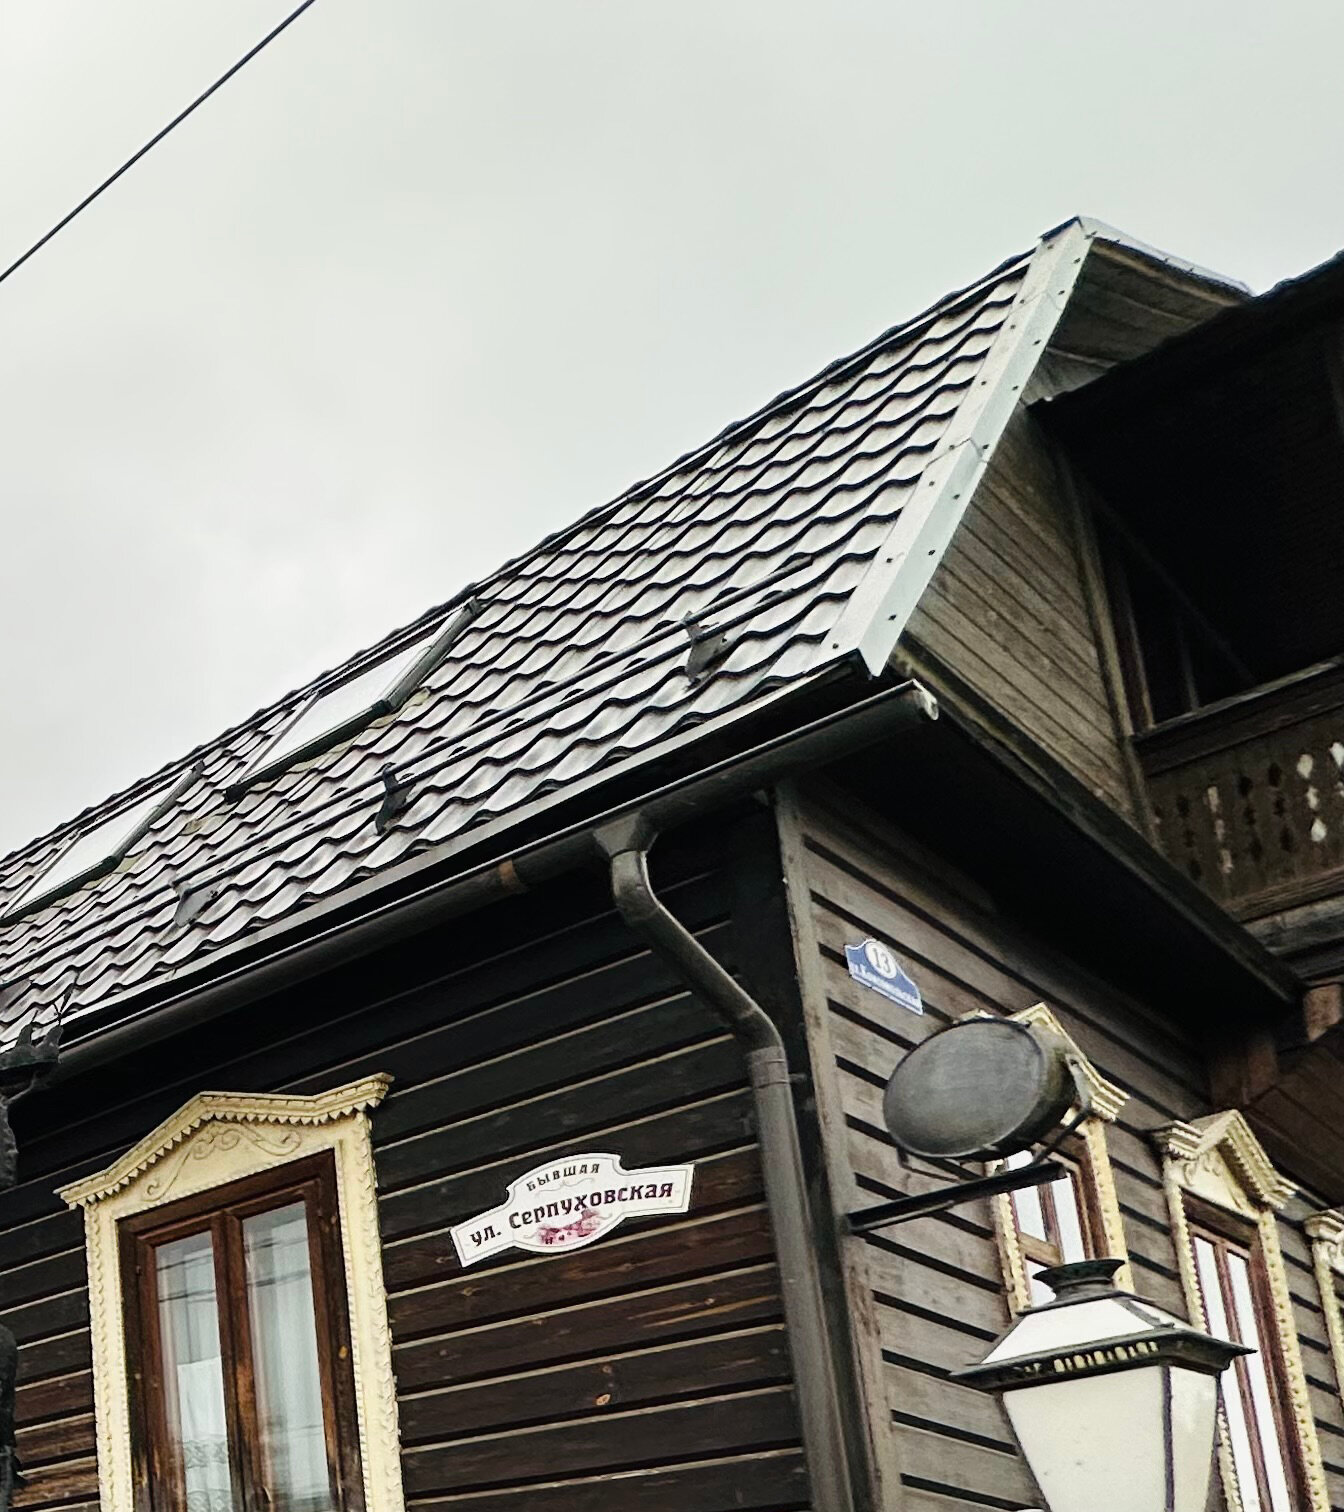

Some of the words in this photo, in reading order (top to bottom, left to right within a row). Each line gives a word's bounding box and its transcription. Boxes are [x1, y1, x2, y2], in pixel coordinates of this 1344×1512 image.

[872, 947, 891, 973] 13
[525, 1162, 601, 1192] БЫВШАЯ
[470, 1228, 502, 1247] ул.
[508, 1181, 674, 1230] Серпуховская
